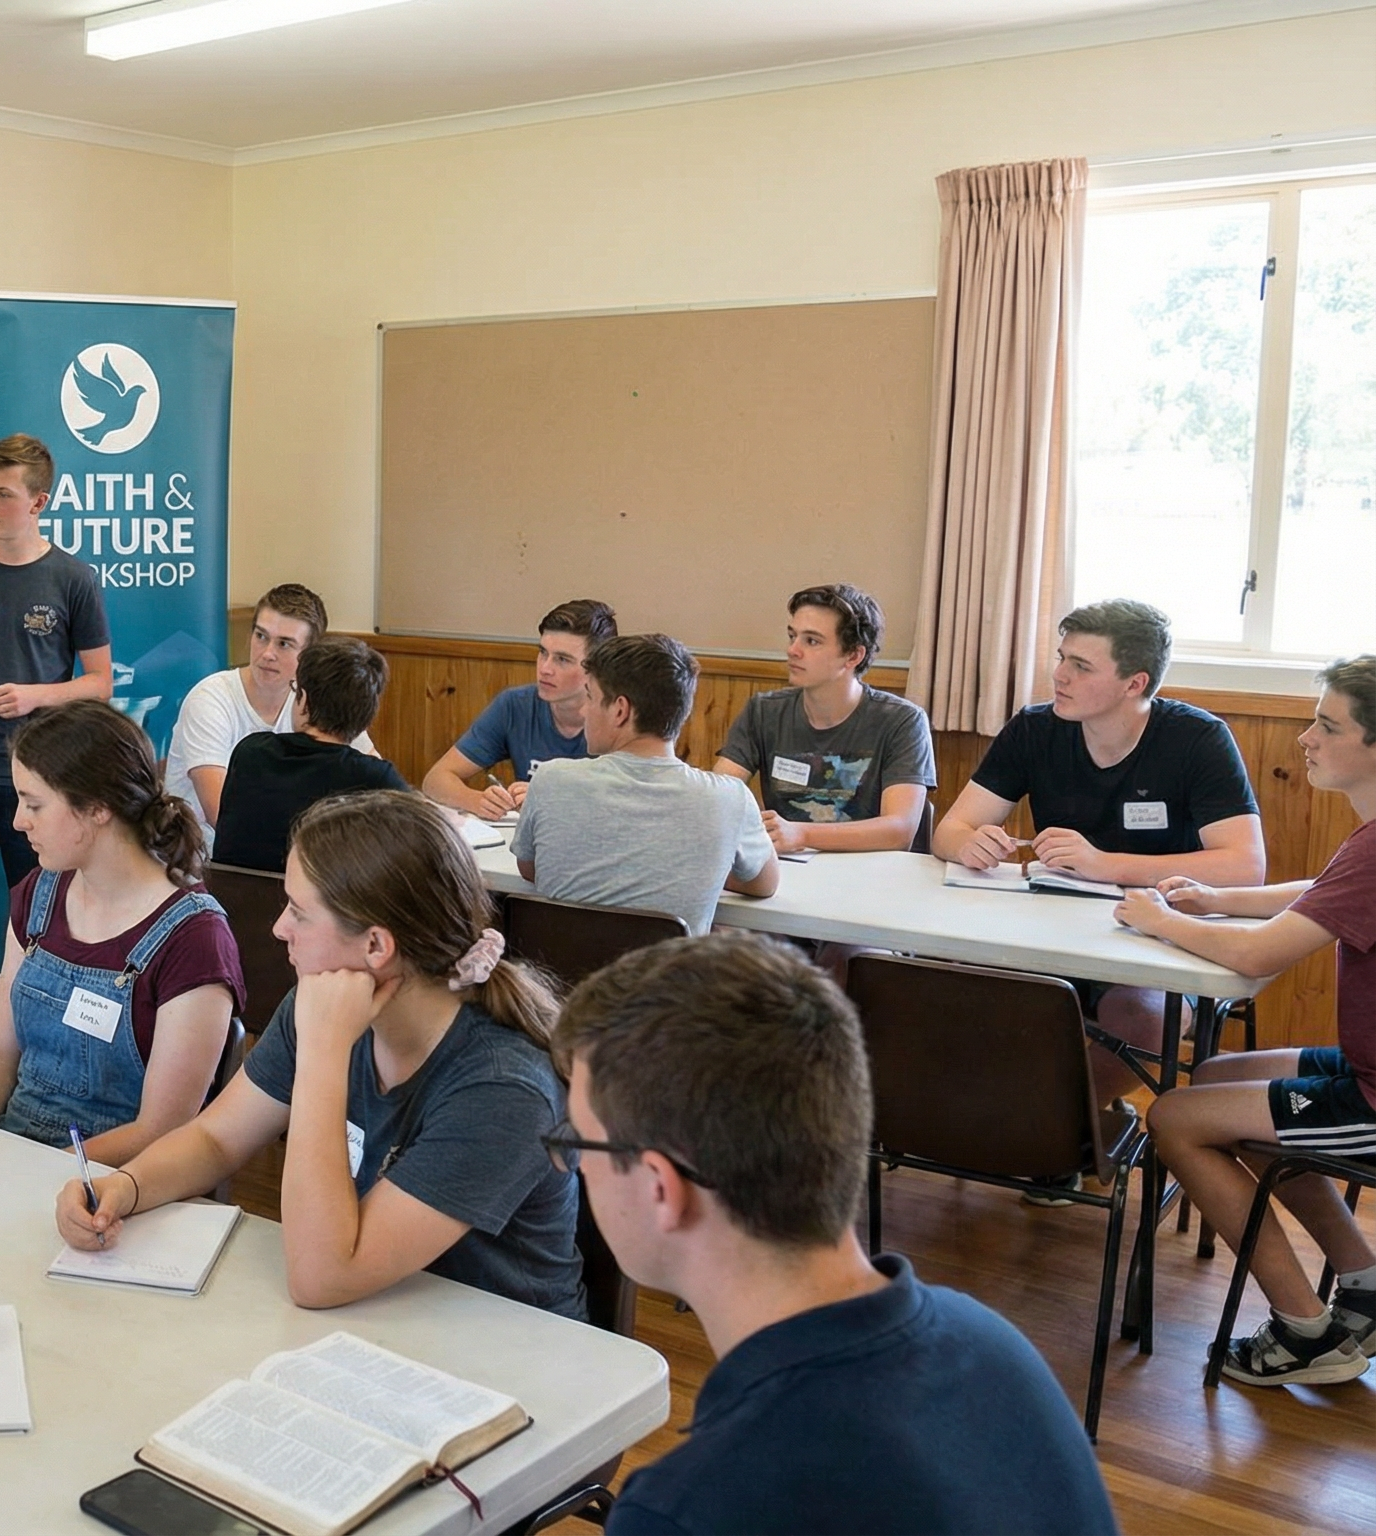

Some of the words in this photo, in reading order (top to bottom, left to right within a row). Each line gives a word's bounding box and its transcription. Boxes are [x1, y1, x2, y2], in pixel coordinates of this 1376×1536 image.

[50, 473, 154, 511] AITH
[164, 473, 194, 511] &
[88, 562, 195, 588] KSHOP
